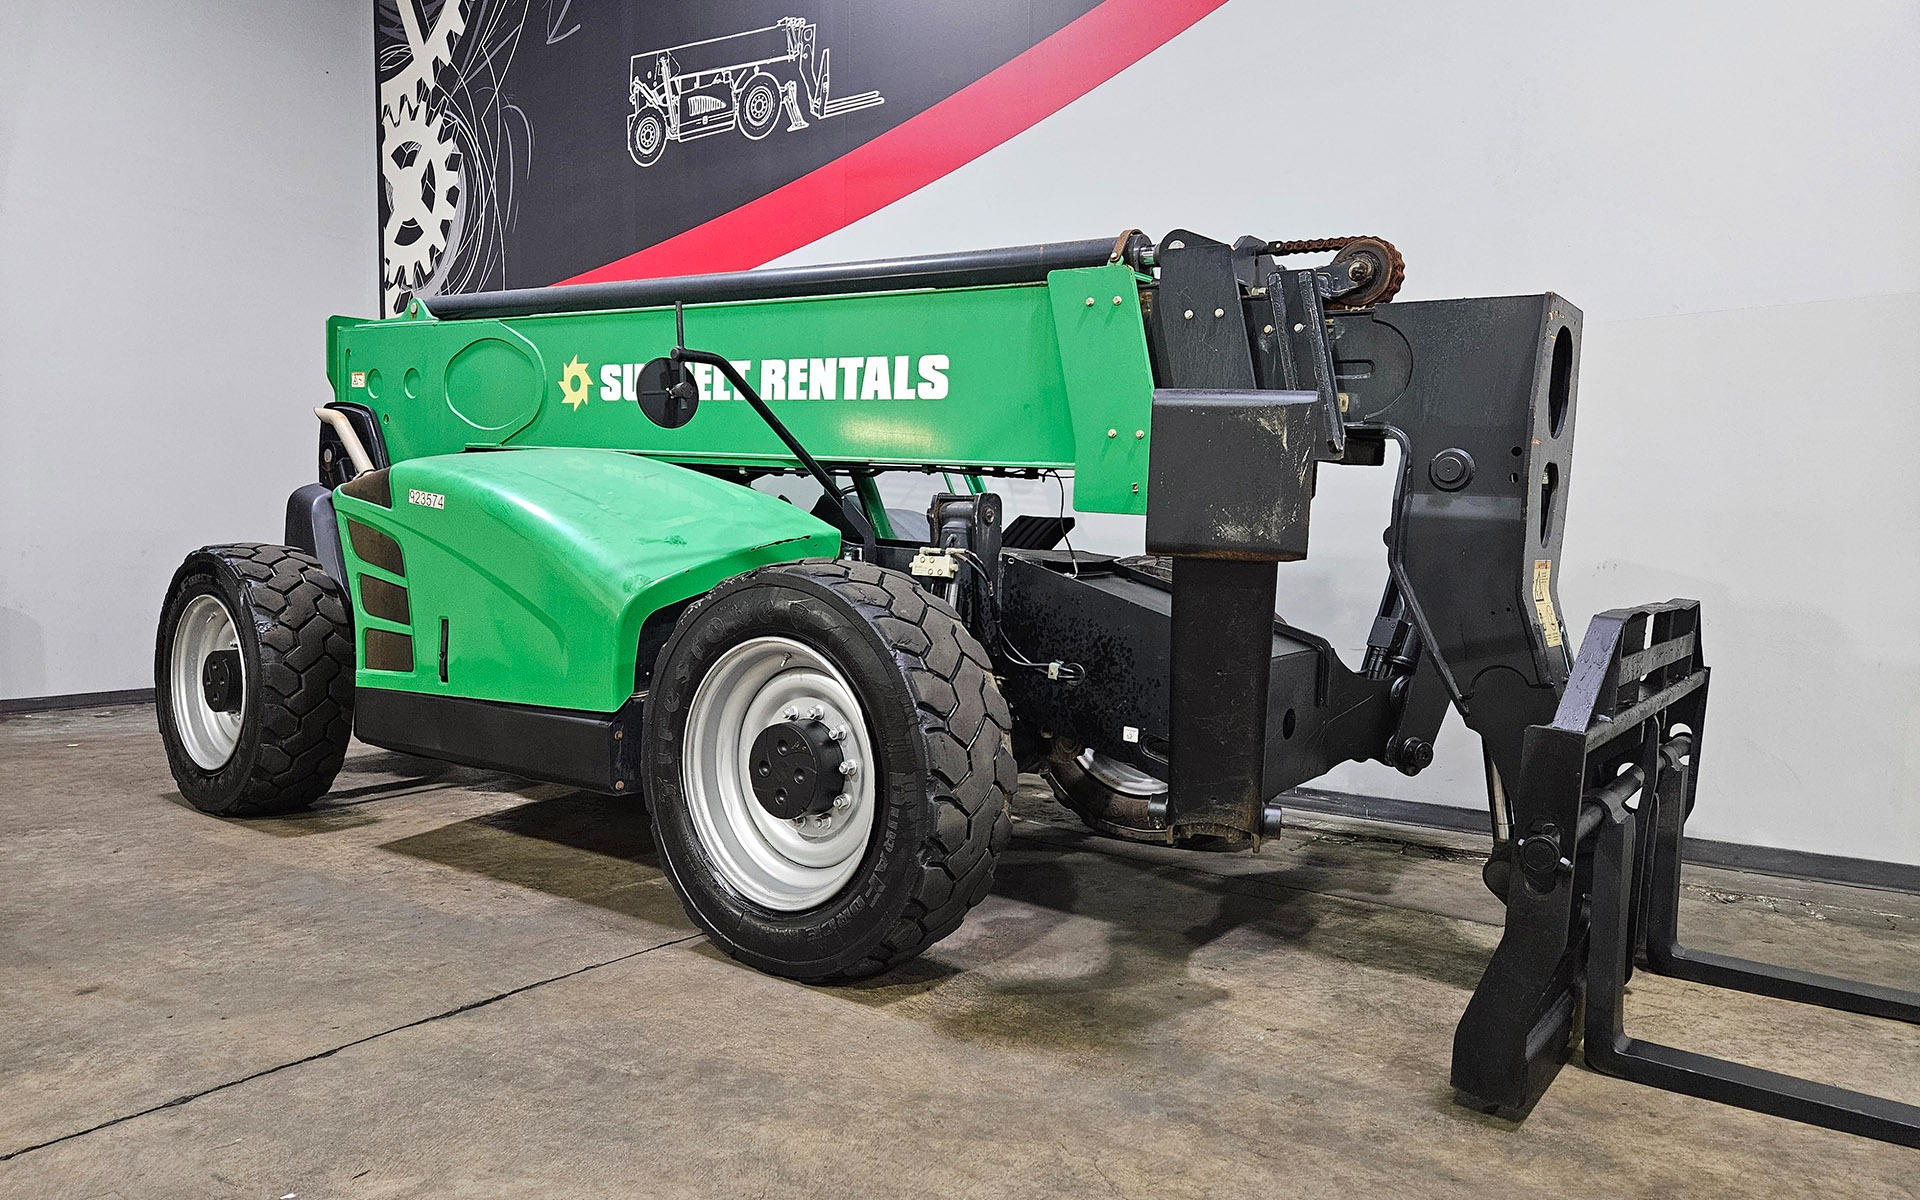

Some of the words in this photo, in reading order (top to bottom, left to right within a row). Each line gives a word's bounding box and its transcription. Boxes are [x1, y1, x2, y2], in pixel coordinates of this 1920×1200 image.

[600, 360, 750, 401] SUELT
[760, 354, 950, 401] RENTALS
[410, 490, 444, 508] 923574
